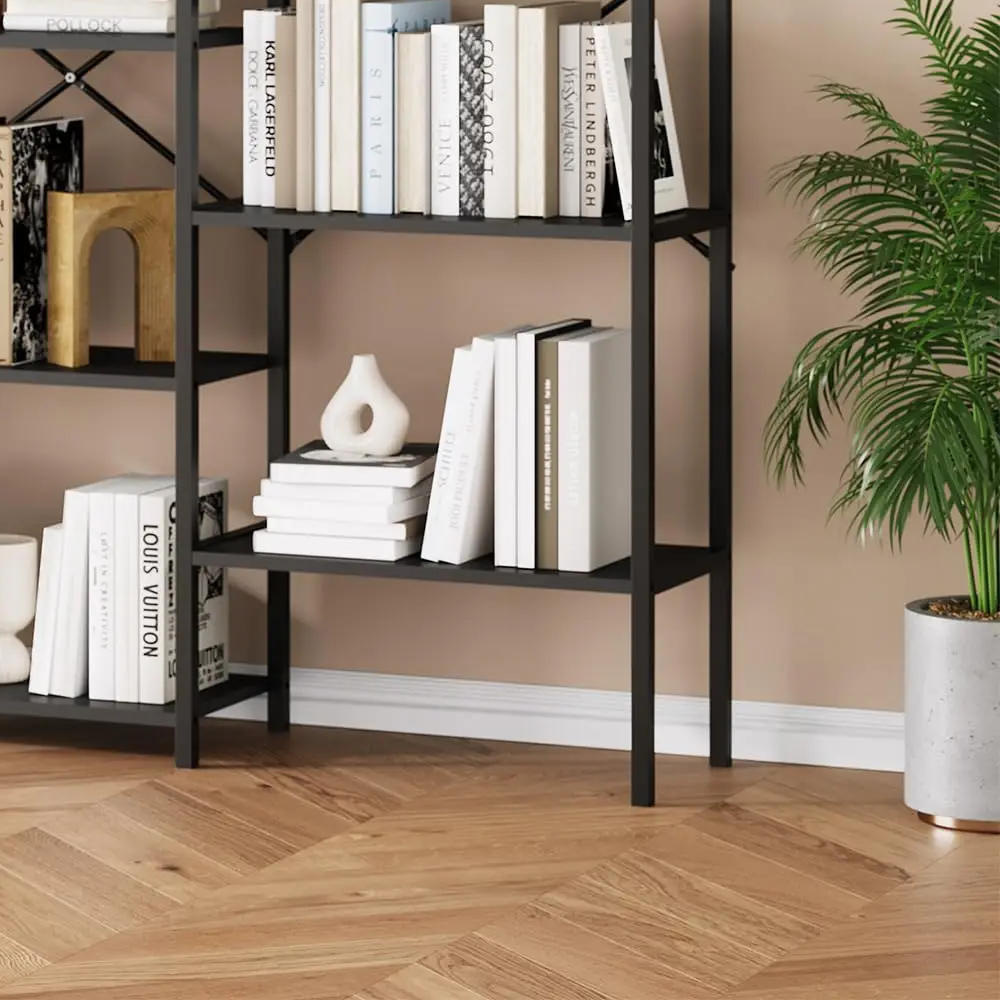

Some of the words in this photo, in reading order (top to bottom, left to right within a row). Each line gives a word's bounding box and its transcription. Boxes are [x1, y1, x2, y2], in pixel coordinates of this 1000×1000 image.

[46, 18, 123, 33] POLLOCK
[264, 40, 276, 82] KARL
[585, 36, 597, 93] PETER
[264, 84, 276, 177] LAGERFELD
[369, 68, 383, 179] PARIS
[438, 118, 453, 194] VENICE
[585, 101, 597, 208] LINDBERGH
[142, 524, 159, 575] LOUIS
[142, 584, 159, 658] VUITTON
